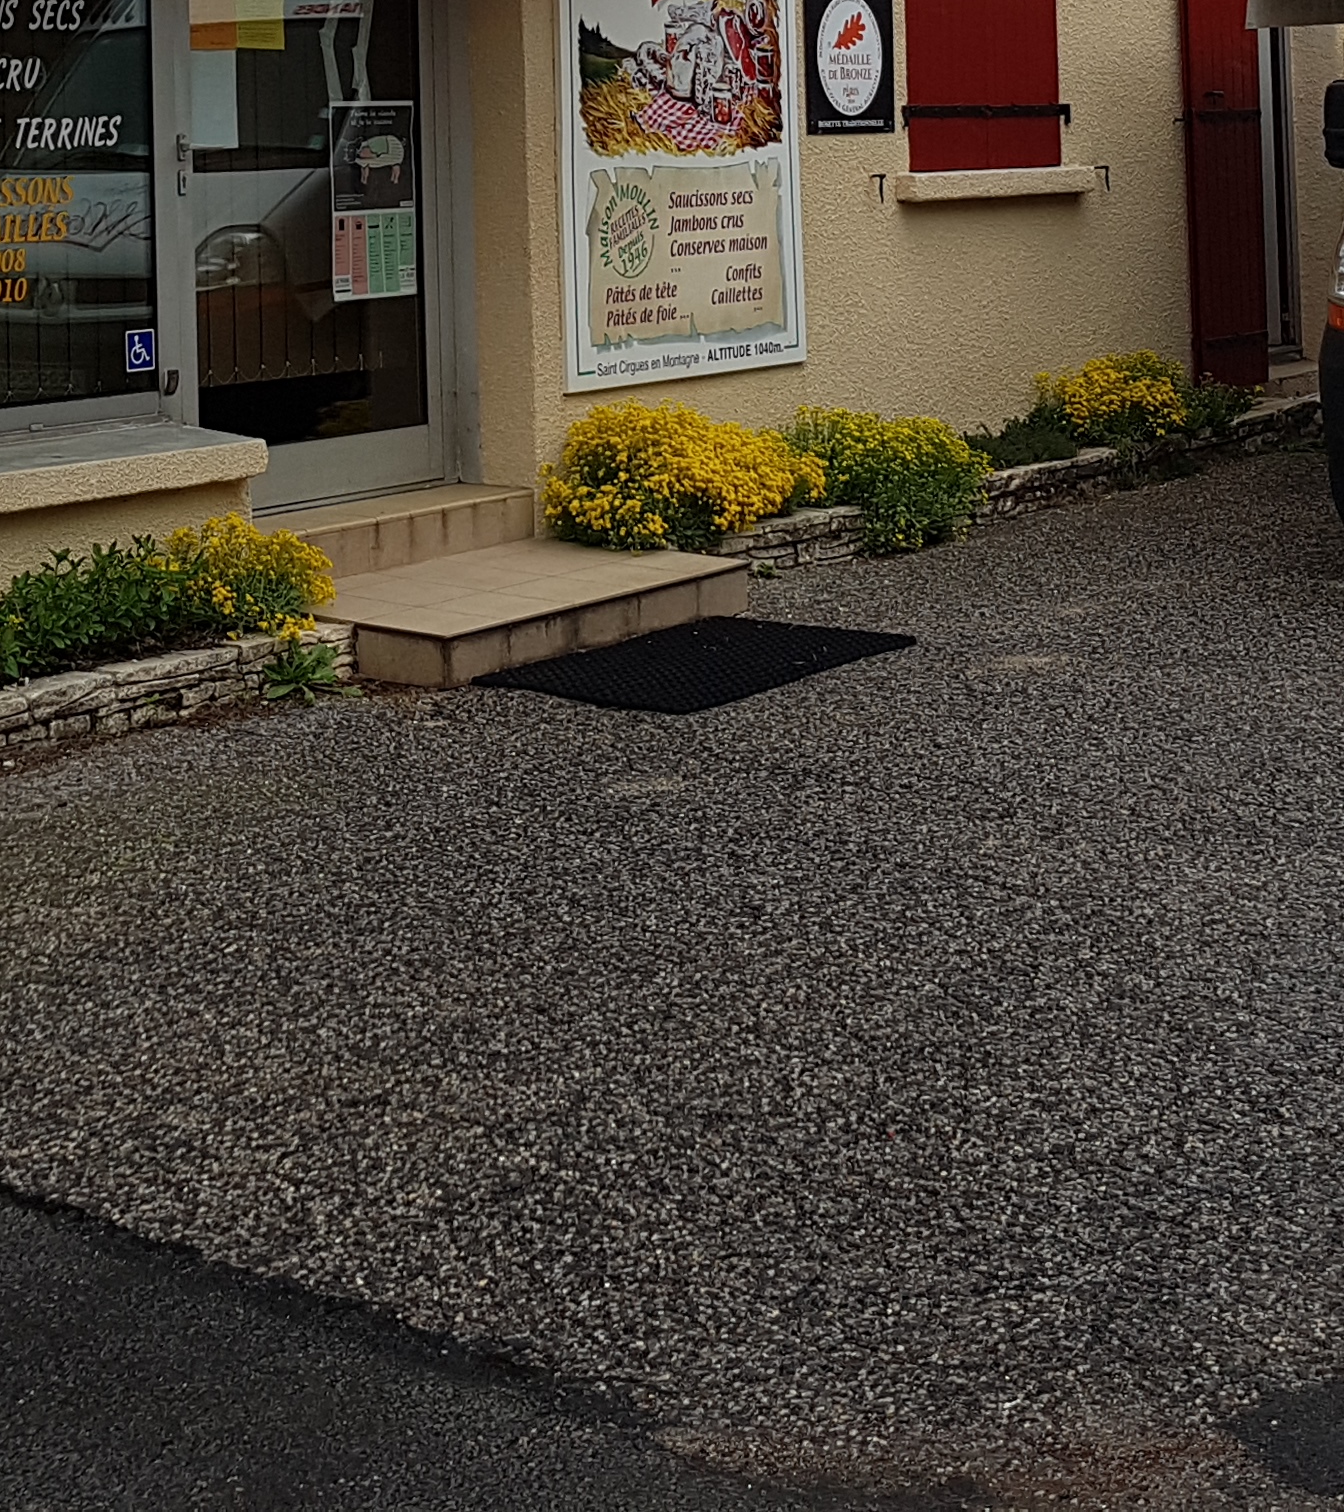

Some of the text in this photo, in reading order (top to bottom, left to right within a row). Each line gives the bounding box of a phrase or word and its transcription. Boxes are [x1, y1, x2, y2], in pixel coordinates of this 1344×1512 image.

[828, 52, 872, 66] MÉDAILLE
[840, 67, 873, 81] BRONZE
[16, 114, 122, 150] TERRINES
[668, 189, 754, 209] Saucissons secs
[598, 183, 660, 268] Maison MOULIN
[609, 211, 647, 251] FAMILIALES
[610, 205, 640, 234] RECETTES
[668, 214, 744, 236] Jambons crus
[618, 231, 645, 259] Depuis
[670, 233, 768, 257] Conserves maison
[621, 241, 649, 276] 1946
[725, 262, 762, 283] Confits
[606, 281, 678, 305] Pâtés de tête
[711, 286, 763, 305] Caillettes
[607, 308, 637, 328] Pâtés
[640, 307, 653, 324] de
[656, 303, 677, 325] foie
[597, 362, 617, 377] Saint
[619, 359, 649, 376] Cirgues
[651, 360, 660, 370] en
[662, 352, 700, 369] Montagne
[707, 345, 751, 362] ALTITUDE
